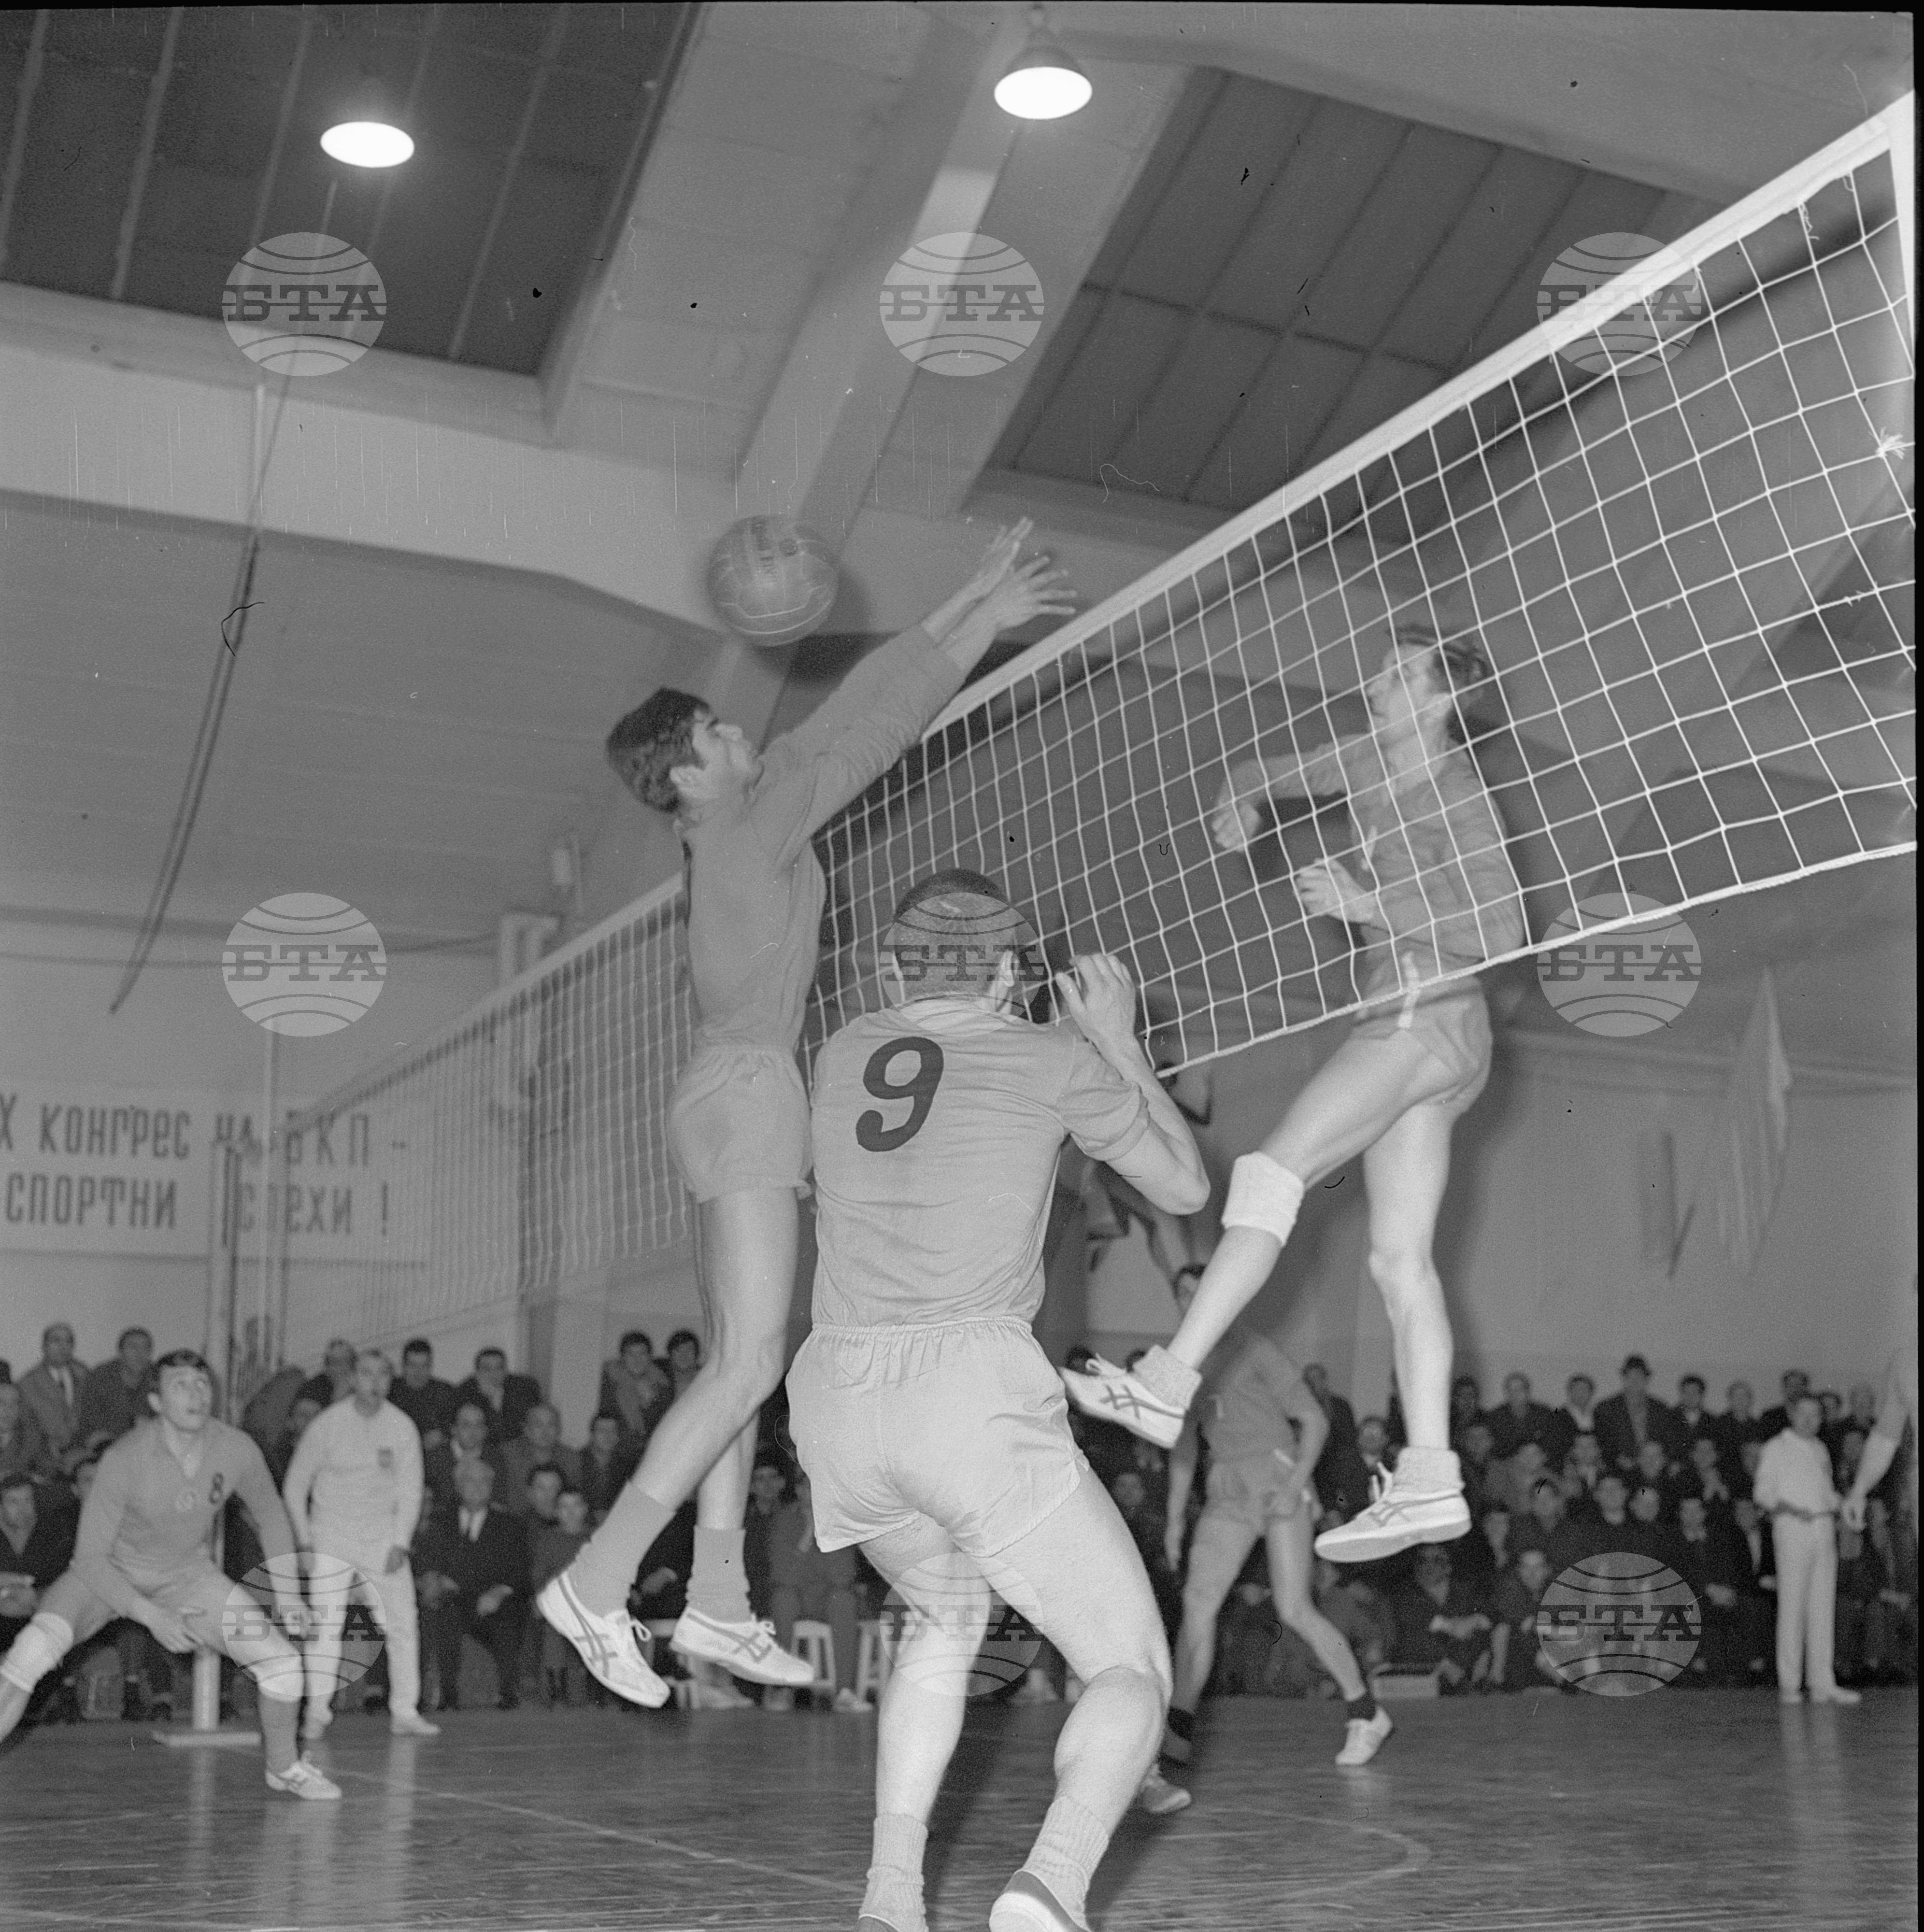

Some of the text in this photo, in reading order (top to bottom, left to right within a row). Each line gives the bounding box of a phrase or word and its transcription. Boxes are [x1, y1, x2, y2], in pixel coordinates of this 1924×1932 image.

[855, 1037, 944, 1152] 9
[39, 1103, 191, 1160] КОНГРЕС
[5, 1172, 177, 1230] СПОРТНИ
[209, 1472, 224, 1506] 8
